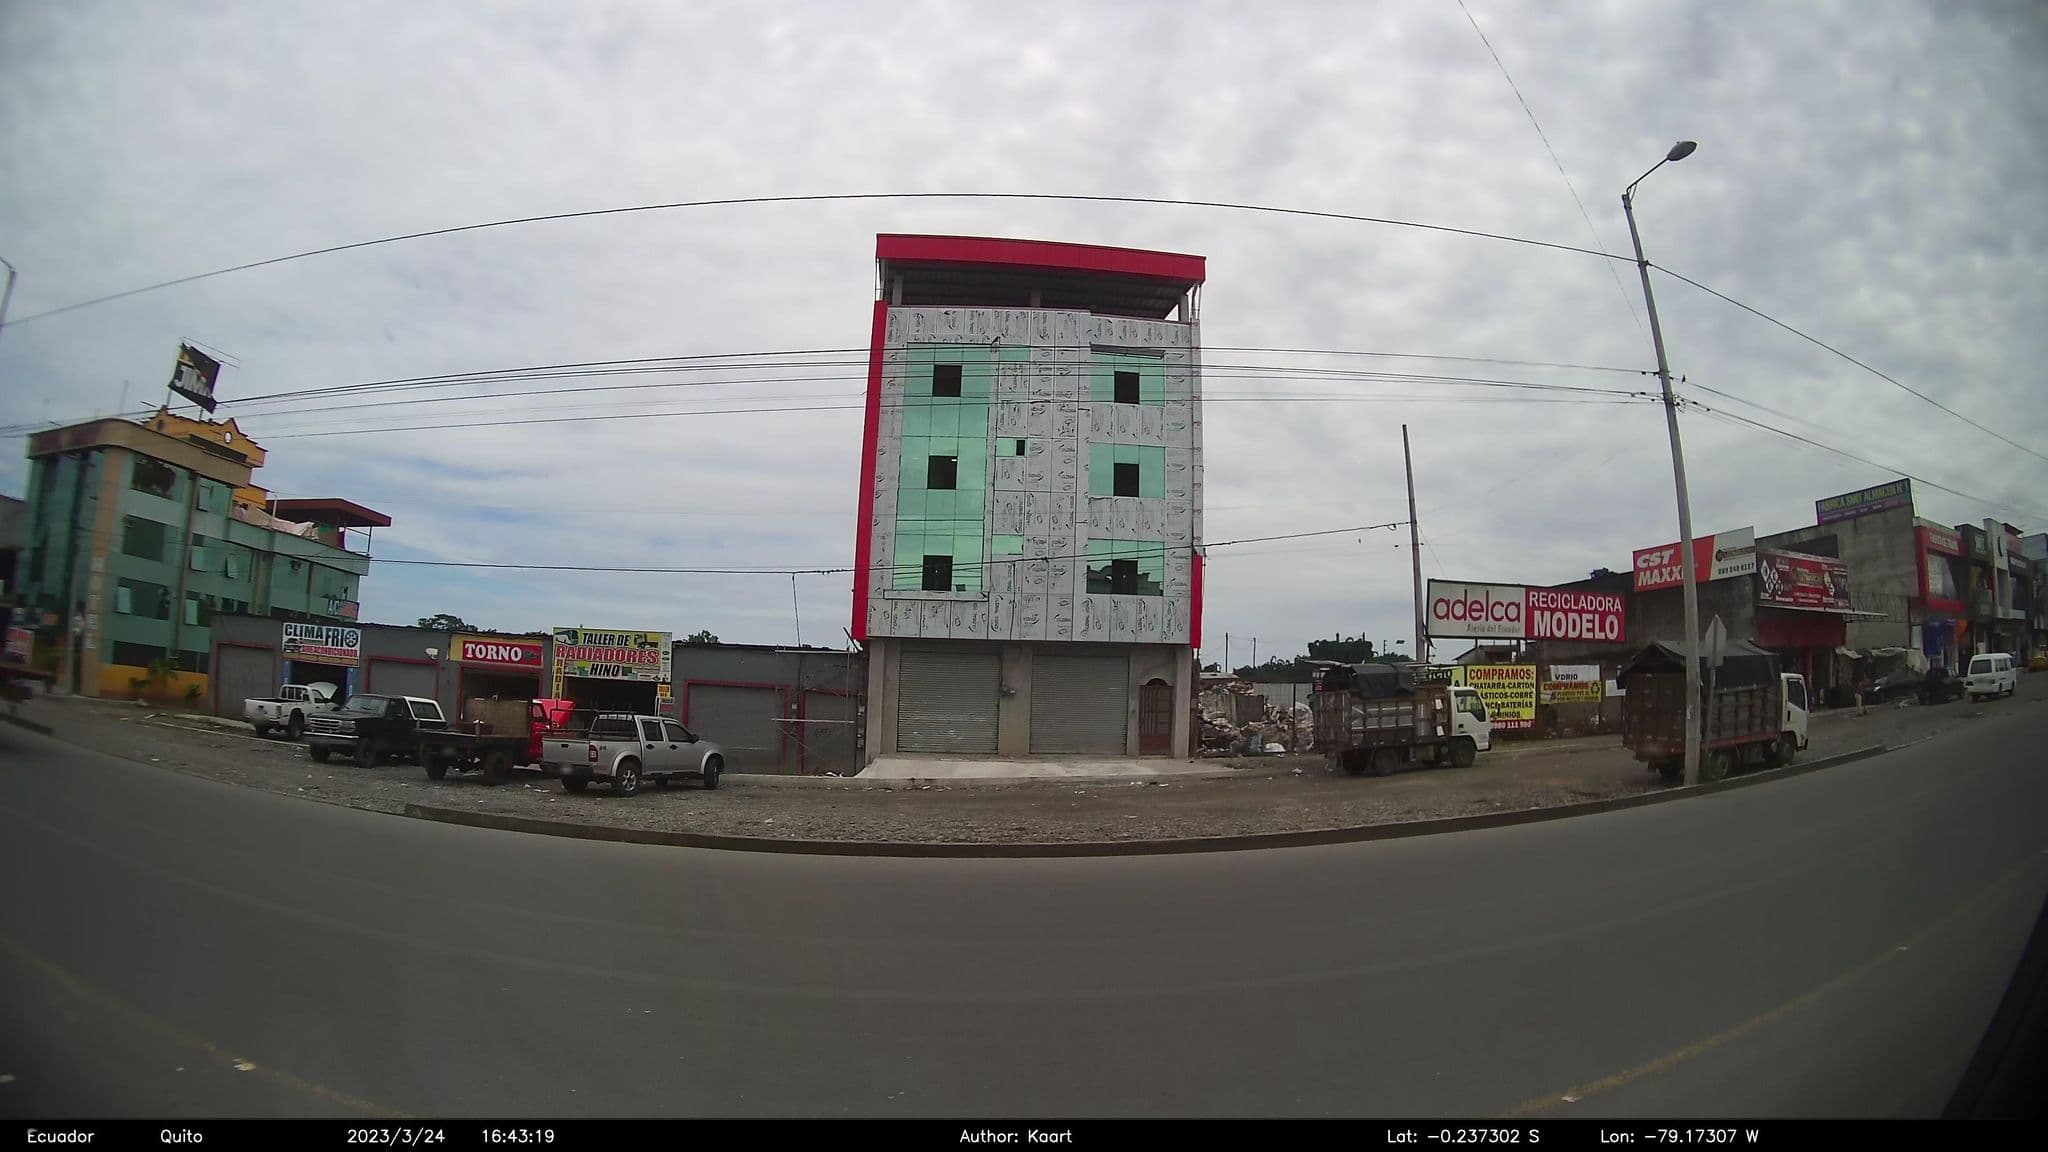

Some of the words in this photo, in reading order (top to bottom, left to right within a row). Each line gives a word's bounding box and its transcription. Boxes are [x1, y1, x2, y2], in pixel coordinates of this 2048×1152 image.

[1637, 549, 1674, 568] CST
[1638, 565, 1685, 586] MAXX
[1433, 589, 1520, 623] adelca
[1529, 591, 1622, 612] RECICLADORA
[284, 623, 324, 640] CLIMA
[1534, 610, 1619, 640] MODELO
[582, 632, 616, 646] TALLER
[616, 634, 630, 646] DE
[464, 643, 523, 662] TORNO
[555, 644, 660, 666] RADIADORES
[589, 663, 621, 677] HINO
[1469, 668, 1534, 681] COMPRAMOS:
